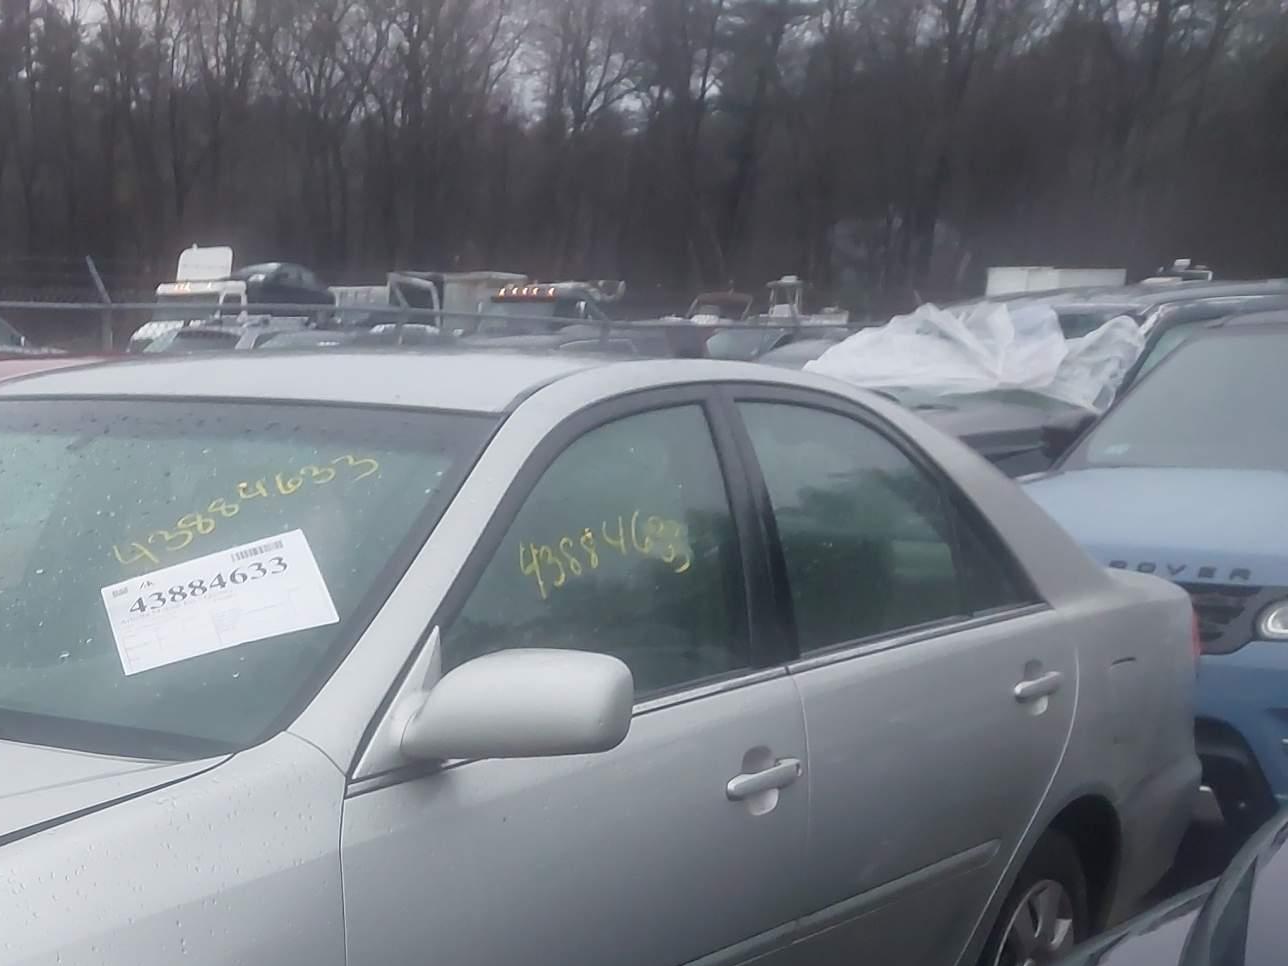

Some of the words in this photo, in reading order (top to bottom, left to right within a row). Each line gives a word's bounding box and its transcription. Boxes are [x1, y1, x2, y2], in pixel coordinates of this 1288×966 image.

[113, 455, 379, 565] 43884633
[128, 556, 289, 614] 43884633
[1108, 559, 1251, 581] ROVER
